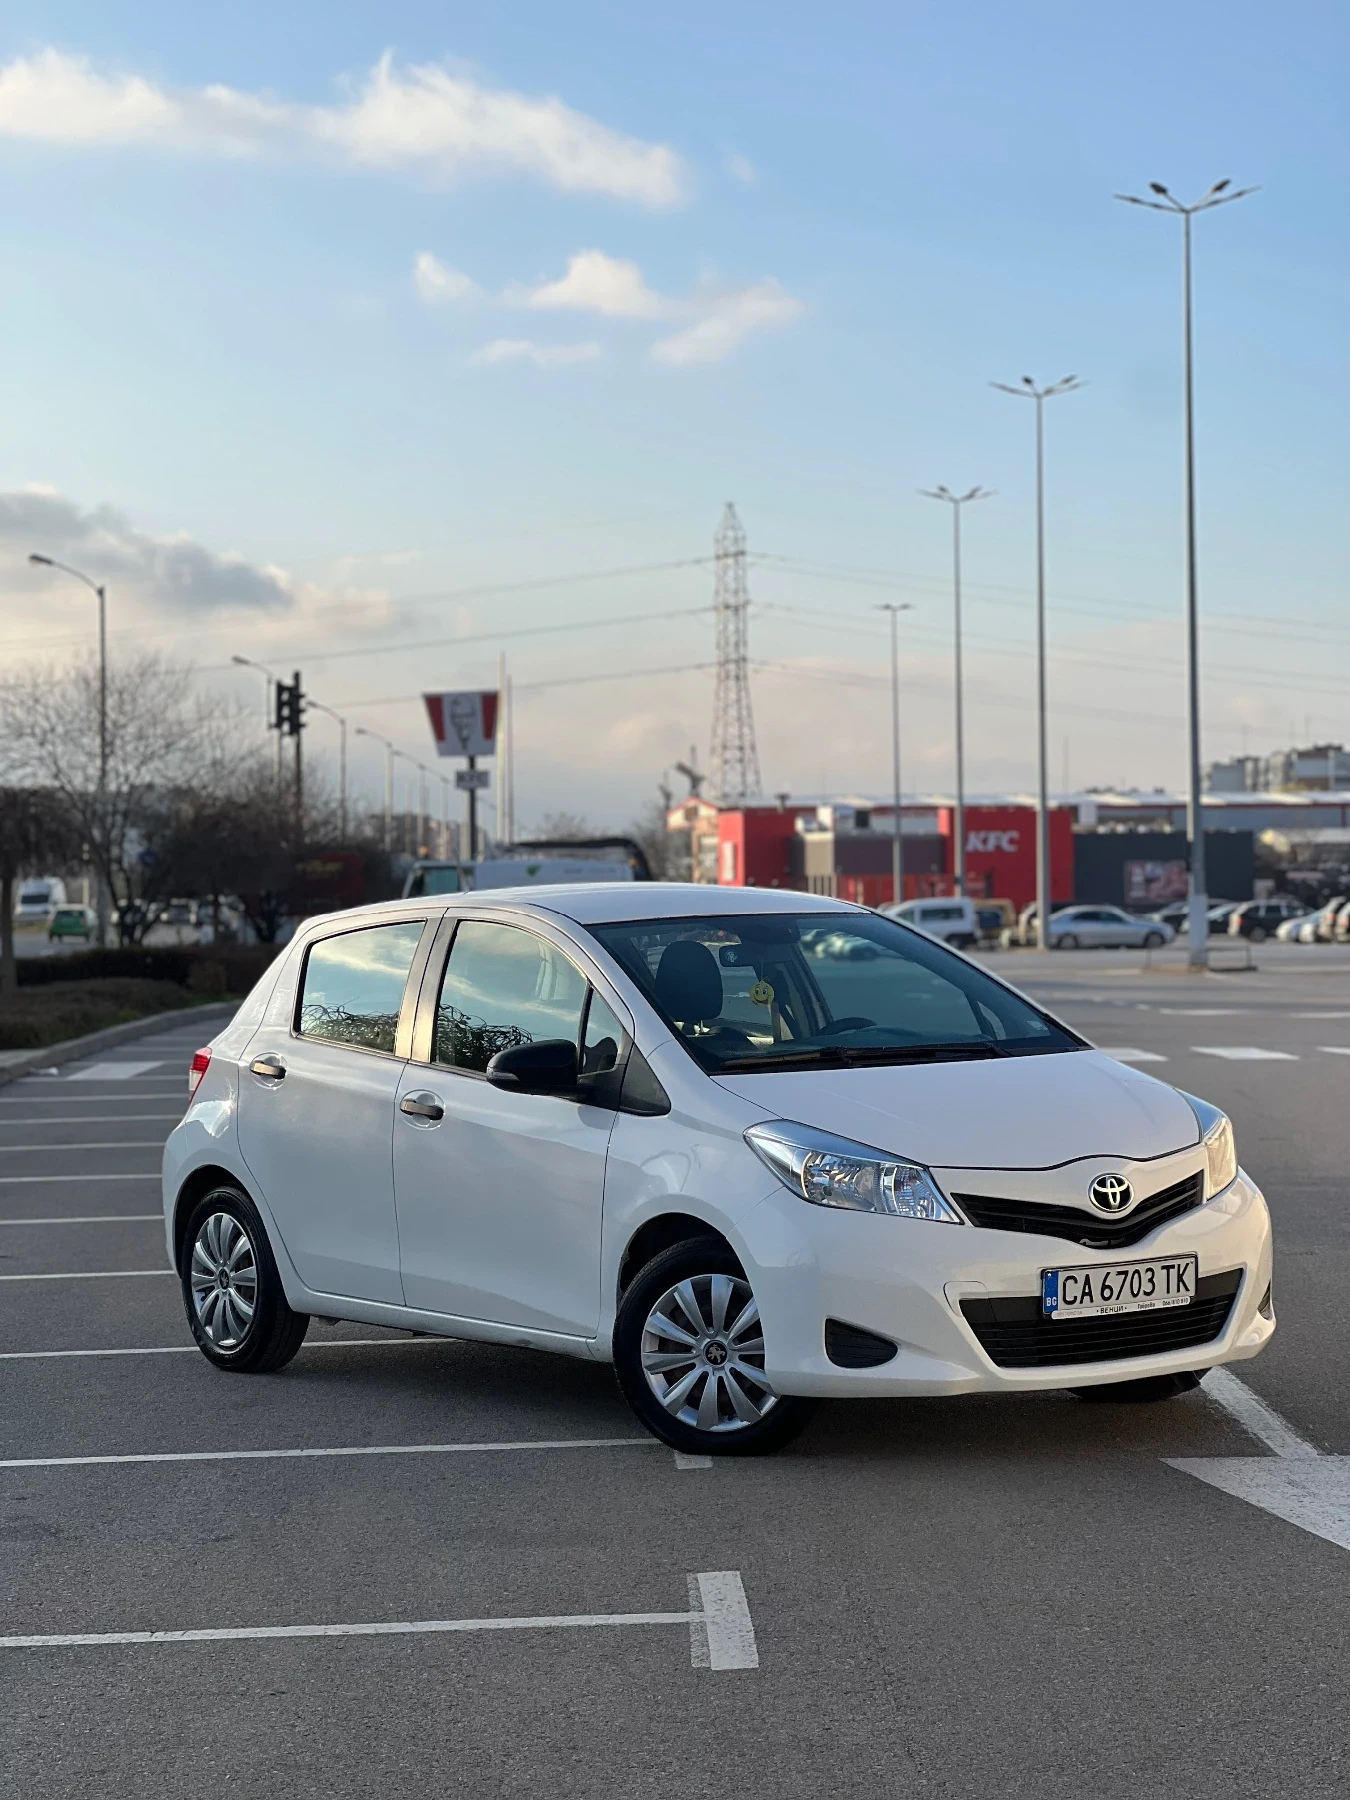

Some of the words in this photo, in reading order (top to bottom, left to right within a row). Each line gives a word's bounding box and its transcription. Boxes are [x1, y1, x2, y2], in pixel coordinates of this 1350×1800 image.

[966, 830, 1020, 852] KFC
[1062, 1273, 1094, 1306] CA
[1100, 1266, 1156, 1302] 6703
[1161, 1262, 1190, 1295] TK
[1046, 1296, 1057, 1307] BG
